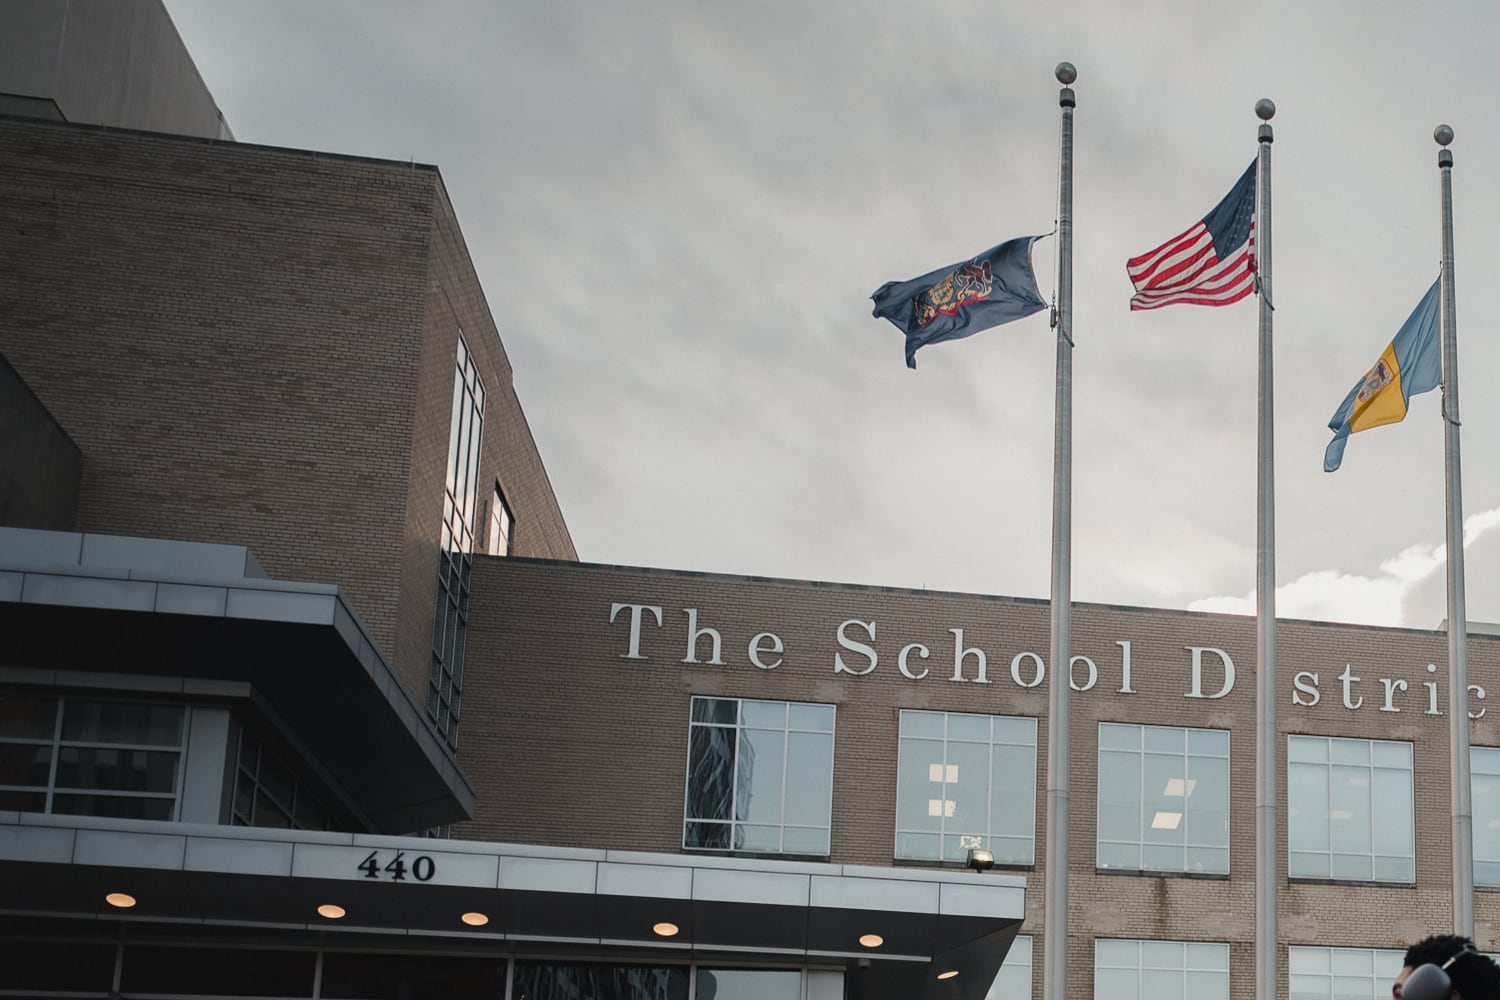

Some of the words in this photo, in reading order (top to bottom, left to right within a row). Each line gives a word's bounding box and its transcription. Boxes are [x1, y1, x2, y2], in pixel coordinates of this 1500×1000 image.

[609, 602, 785, 670] The
[834, 619, 1137, 694] School
[358, 850, 436, 882] 440
